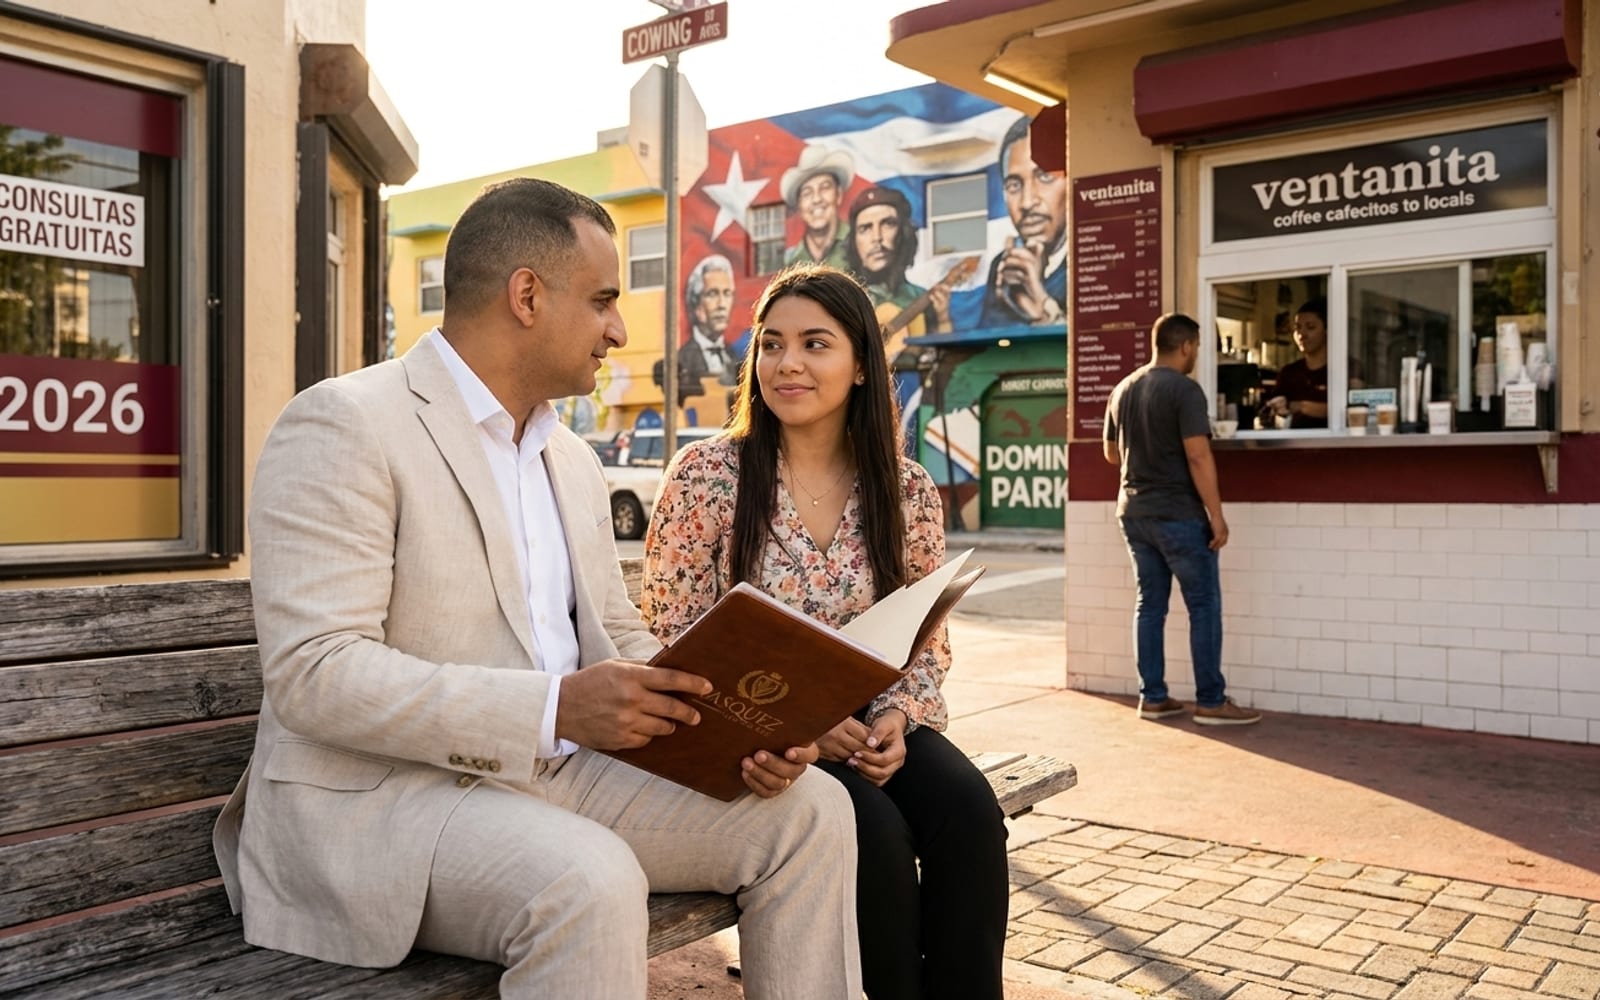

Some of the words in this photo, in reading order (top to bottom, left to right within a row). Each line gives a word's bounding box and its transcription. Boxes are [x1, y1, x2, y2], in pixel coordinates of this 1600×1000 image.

[627, 17, 692, 58] COWING
[1080, 179, 1155, 201] ventanita
[1252, 145, 1500, 210] ventanita
[0, 183, 136, 227] CONSULTAS
[1273, 210, 1322, 228] coffee
[1326, 200, 1399, 222] cafecitos
[1403, 198, 1420, 213] to
[1424, 191, 1475, 210] locals
[0, 216, 132, 257] GRATUITAS
[0, 376, 145, 434] 2026
[991, 476, 1069, 508] PARK
[702, 692, 784, 732] ASQUEZ
